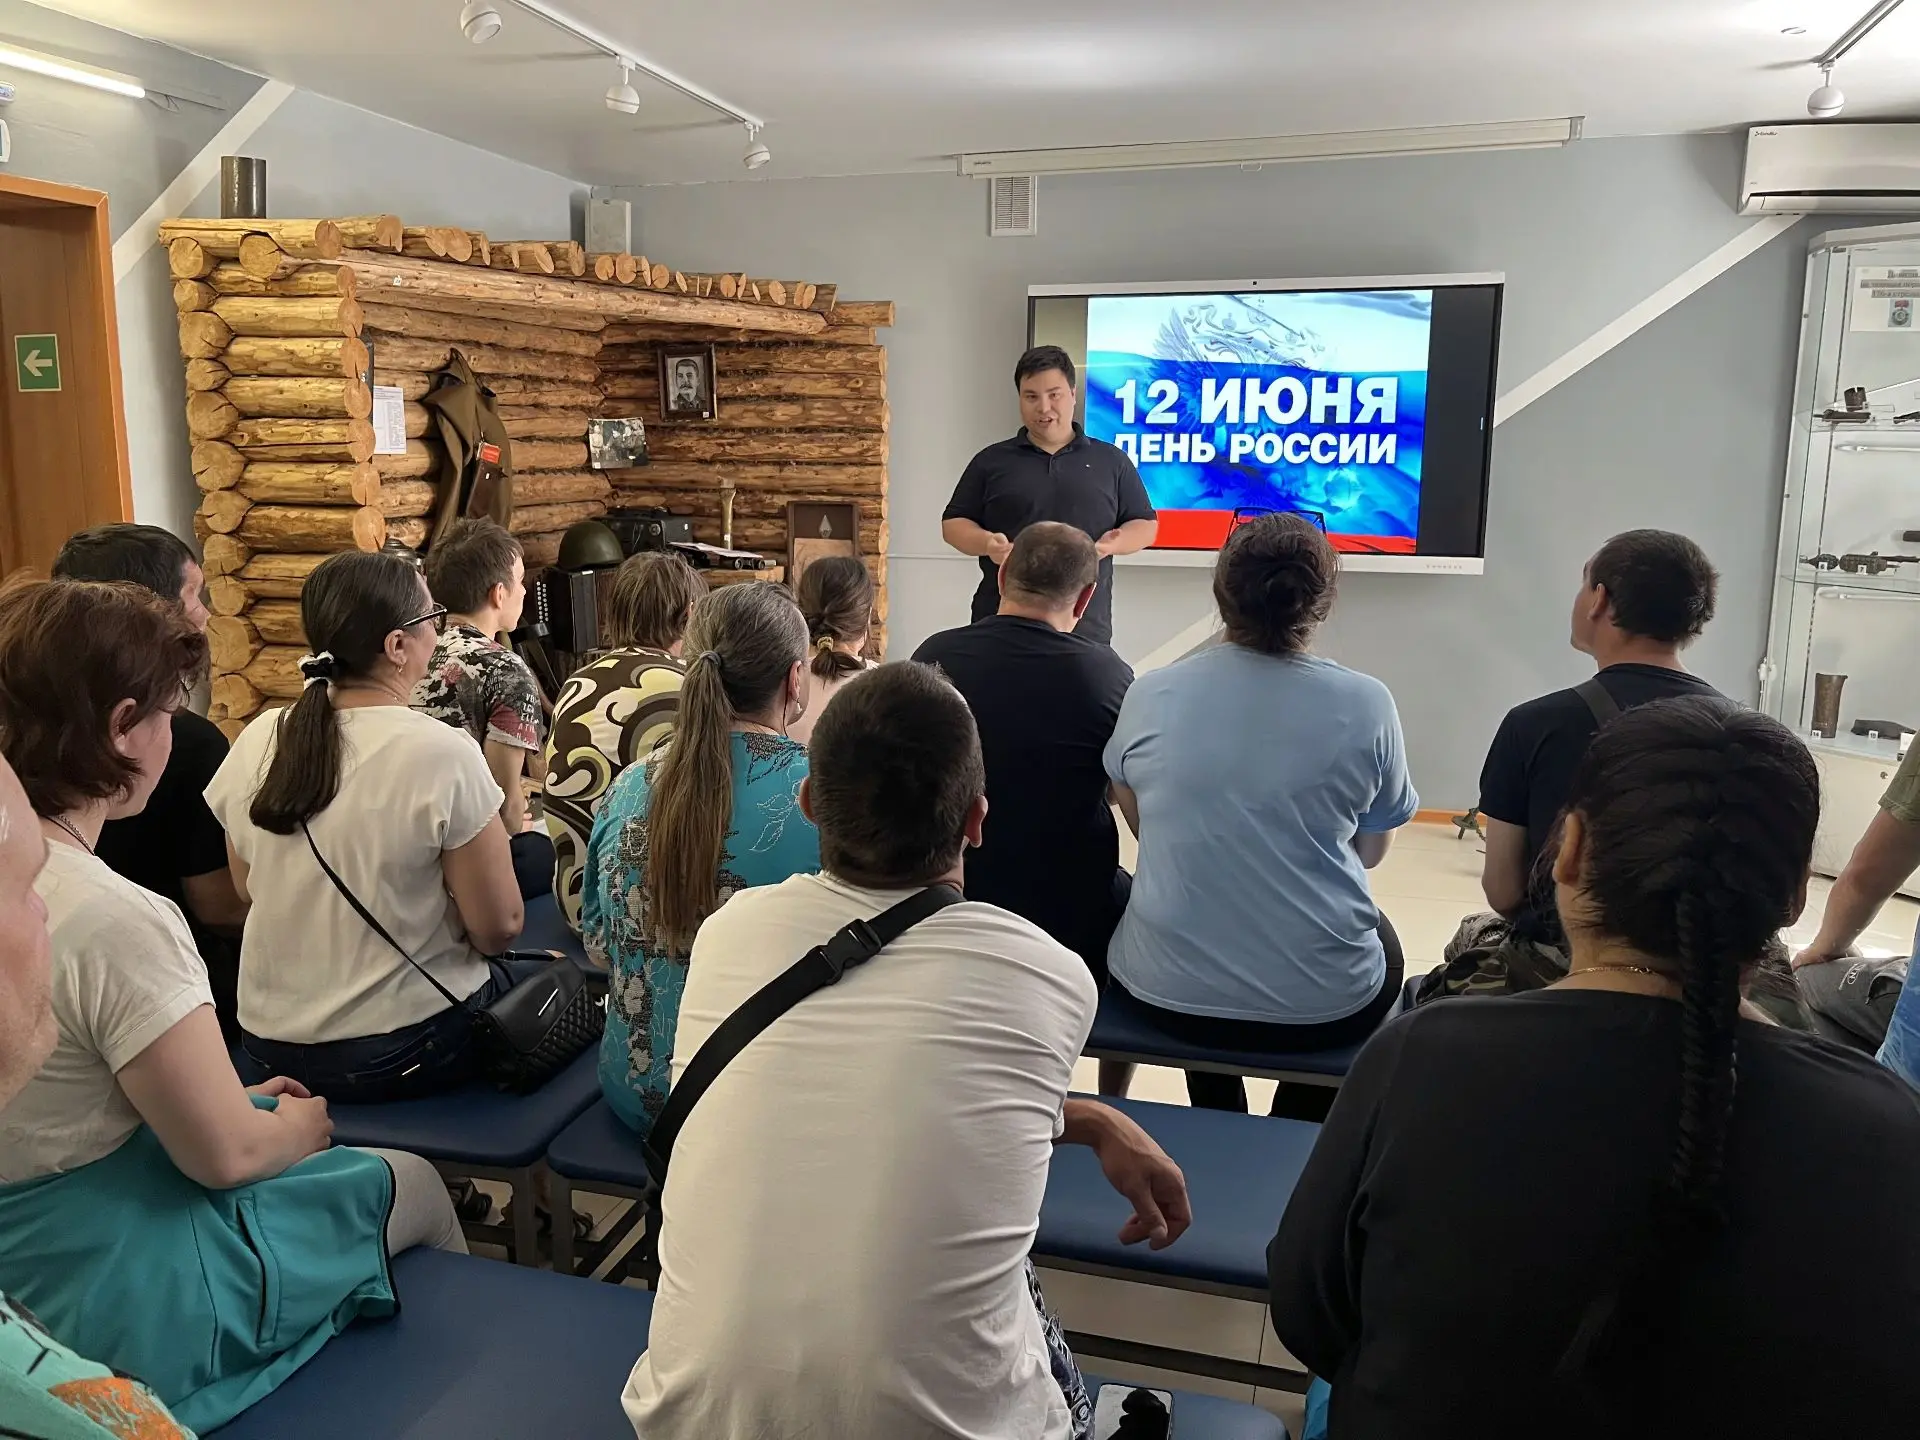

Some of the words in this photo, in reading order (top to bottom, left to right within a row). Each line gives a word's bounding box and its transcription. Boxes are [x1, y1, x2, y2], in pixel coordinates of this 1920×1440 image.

[1115, 379, 1179, 424] 12
[1200, 376, 1398, 425] ИЮНЯ
[1114, 433, 1216, 469] ДЕНЬ
[1229, 432, 1397, 464] РОССИИ
